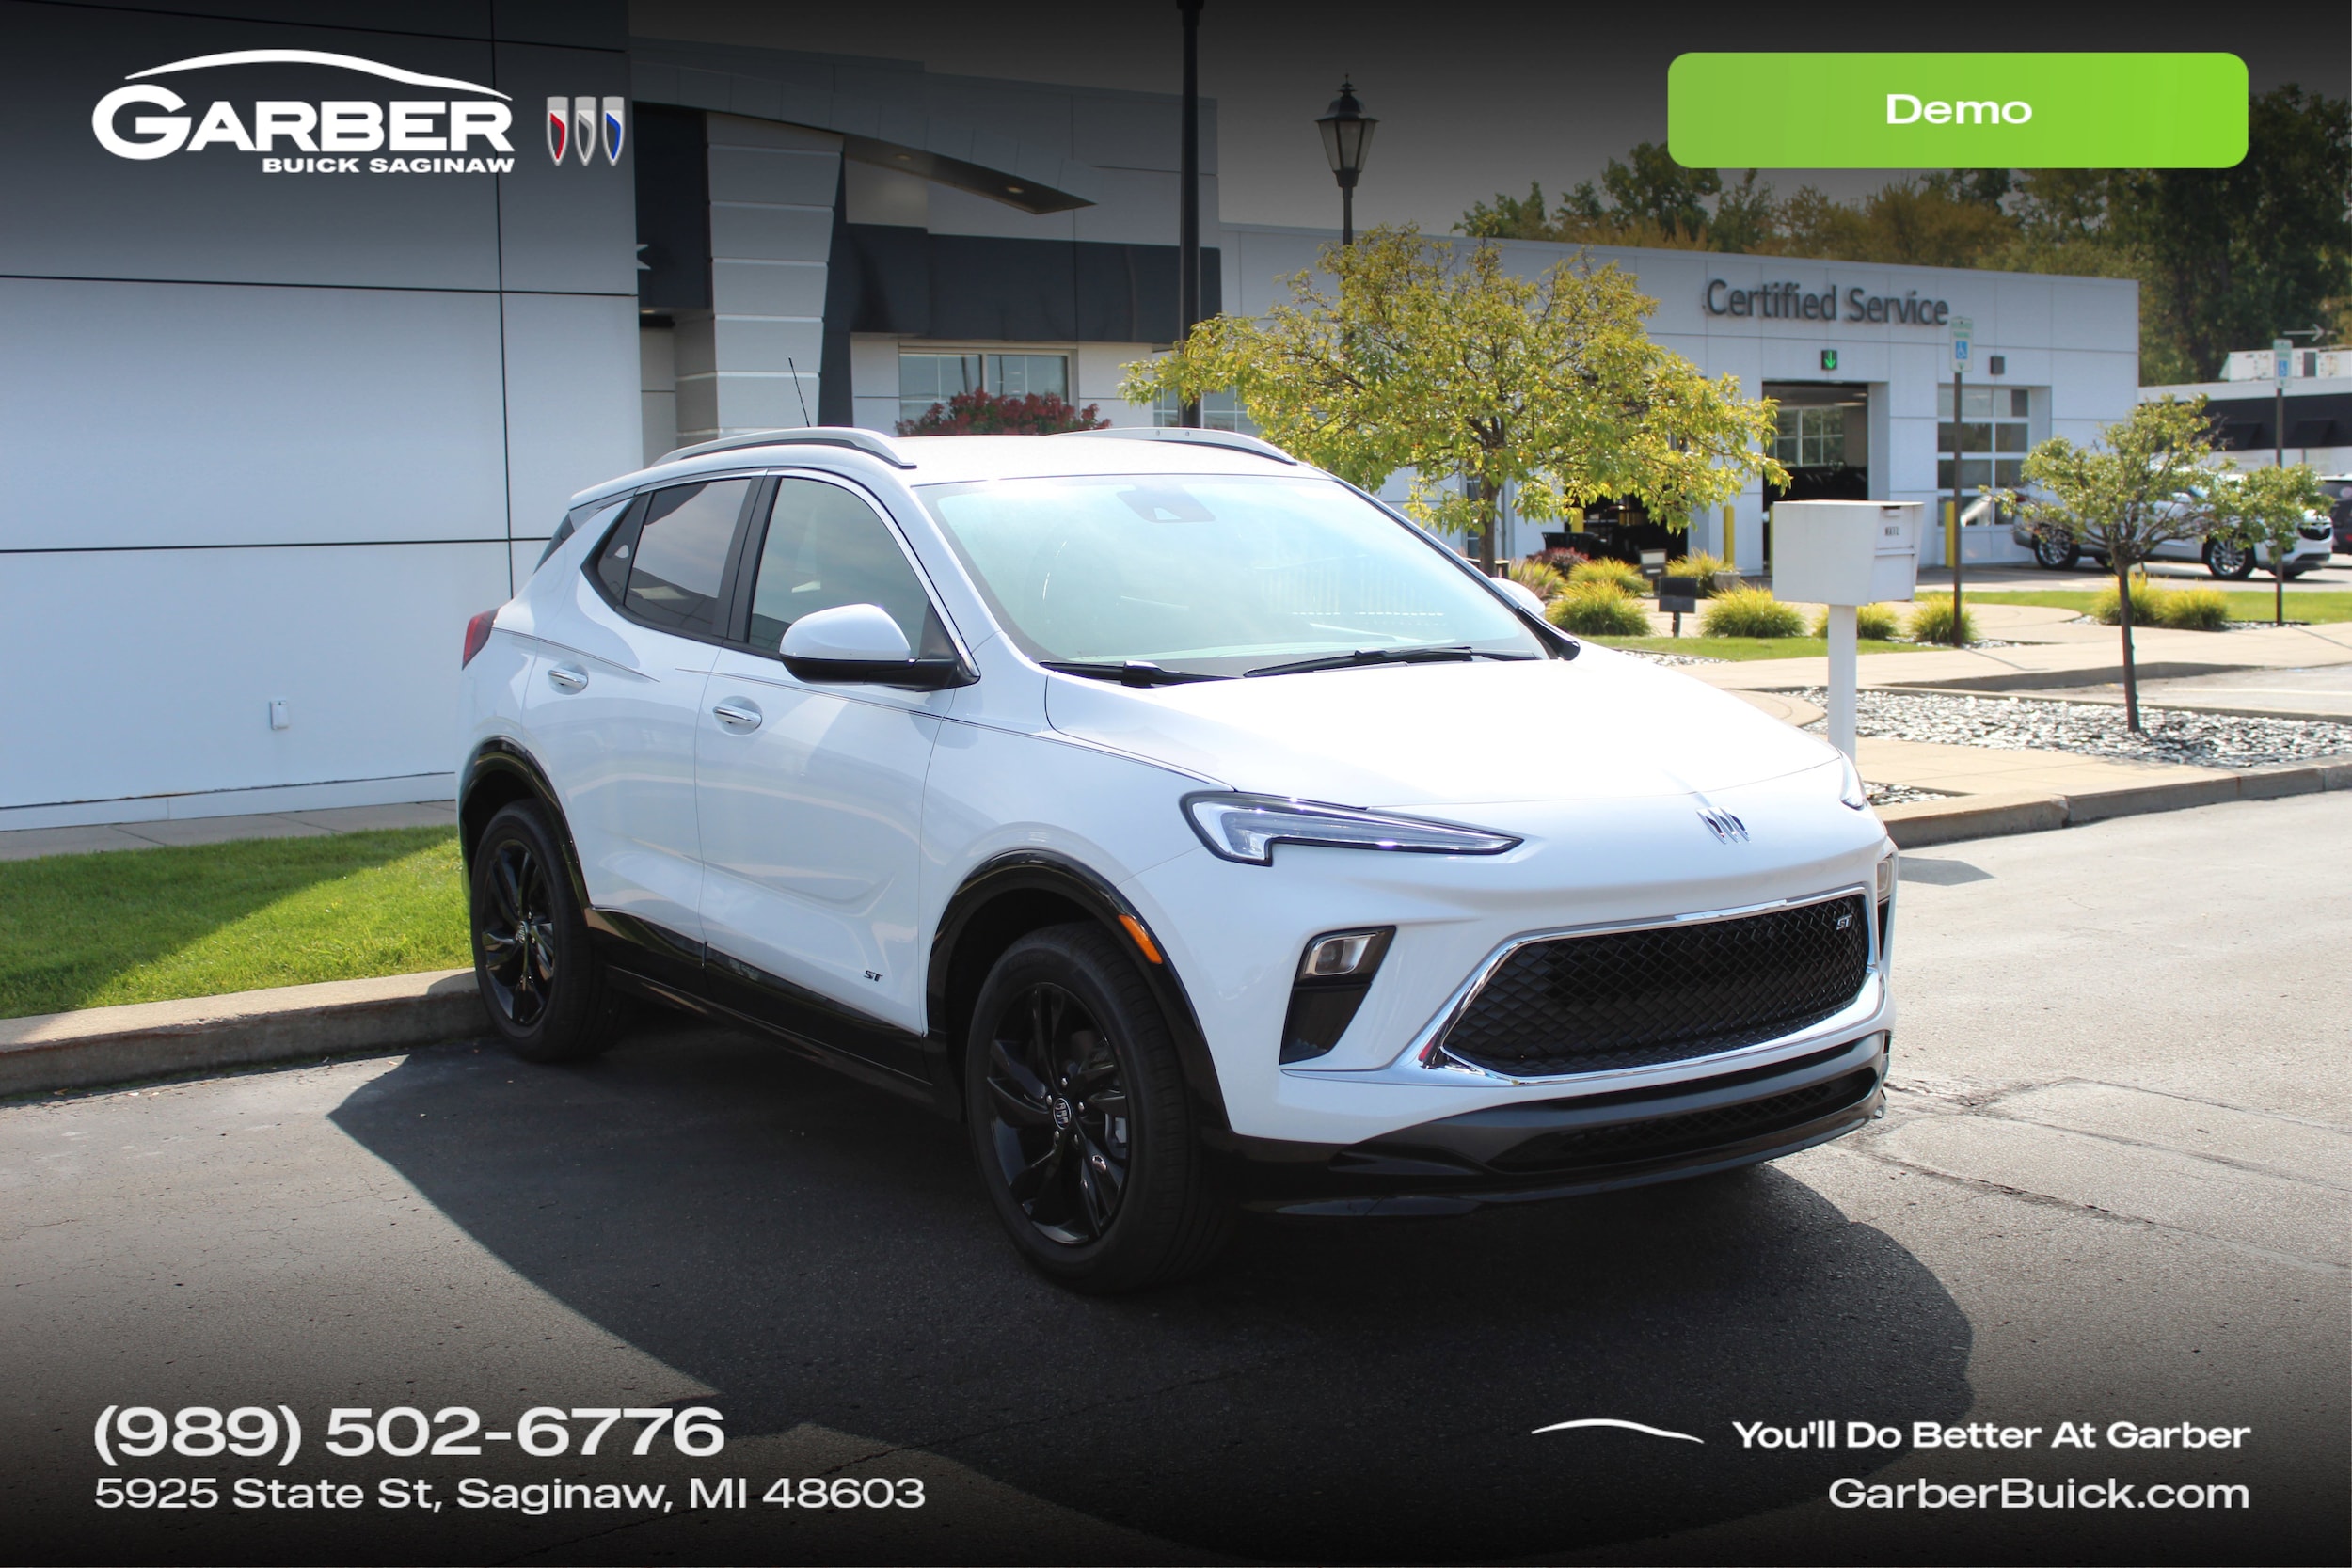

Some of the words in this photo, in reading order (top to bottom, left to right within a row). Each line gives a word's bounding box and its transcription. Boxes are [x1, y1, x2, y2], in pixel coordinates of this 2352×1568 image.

[1705, 278, 1837, 322] Certified
[1846, 287, 1950, 326] Service
[863, 969, 884, 982] ST
